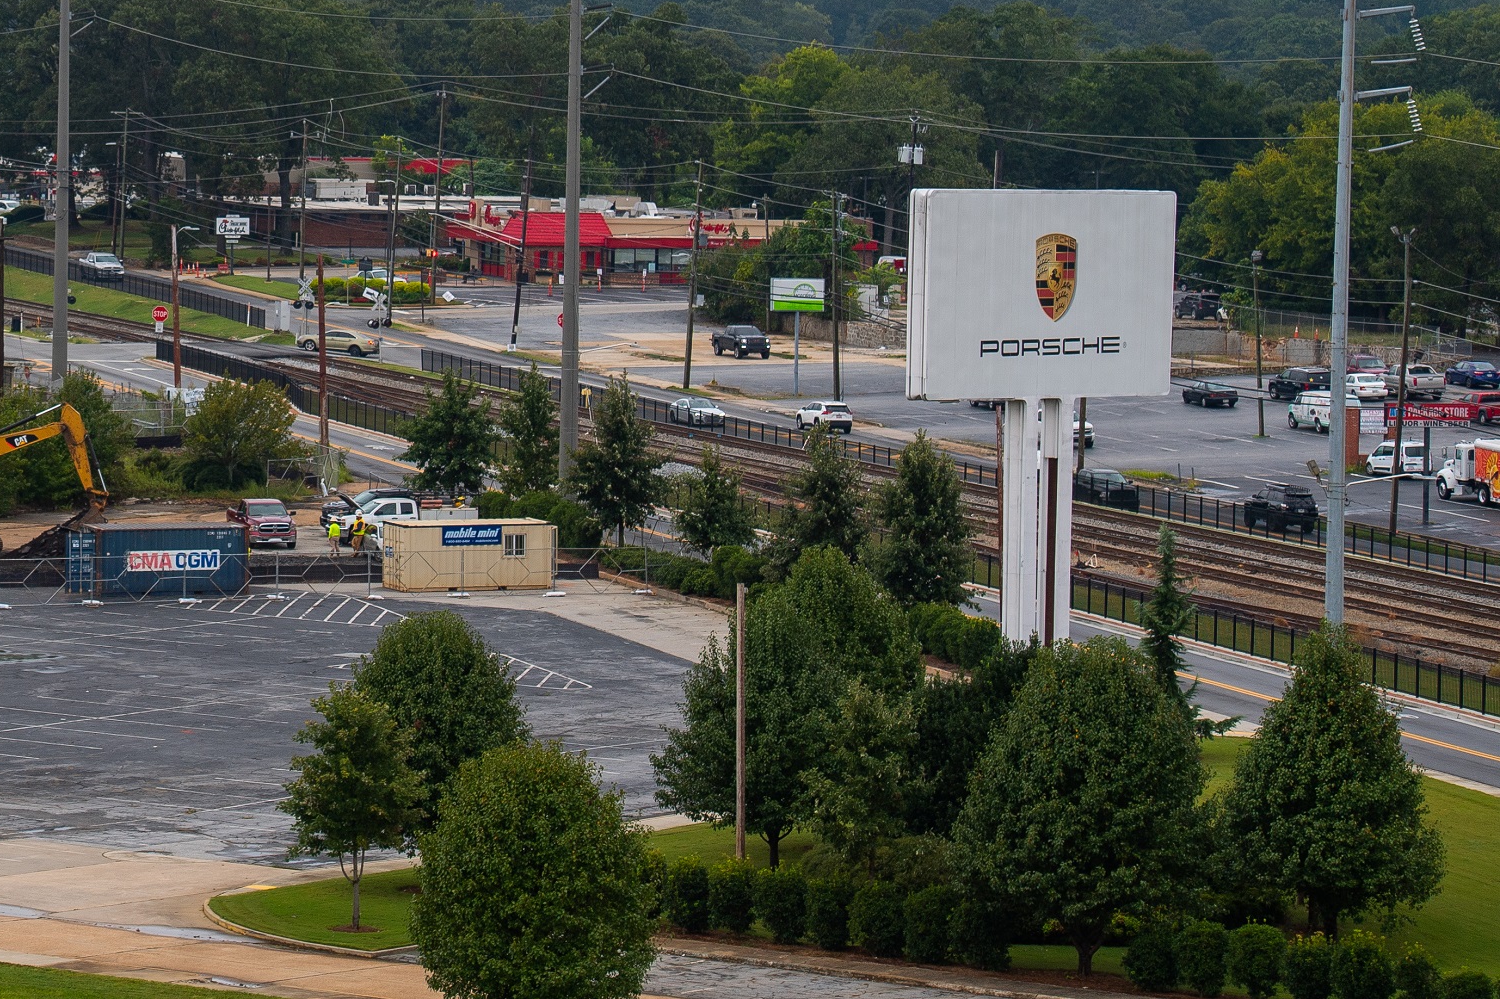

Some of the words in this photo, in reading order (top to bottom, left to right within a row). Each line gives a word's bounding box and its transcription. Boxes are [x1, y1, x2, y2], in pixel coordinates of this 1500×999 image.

[153, 310, 168, 318] STOP
[980, 336, 1120, 358] PORSCHE
[1444, 407, 1469, 418] STORE
[13, 435, 28, 447] CAT
[444, 527, 477, 538] mobile
[477, 528, 499, 538] mini
[129, 552, 172, 570] CMA
[175, 551, 218, 569] CGM
